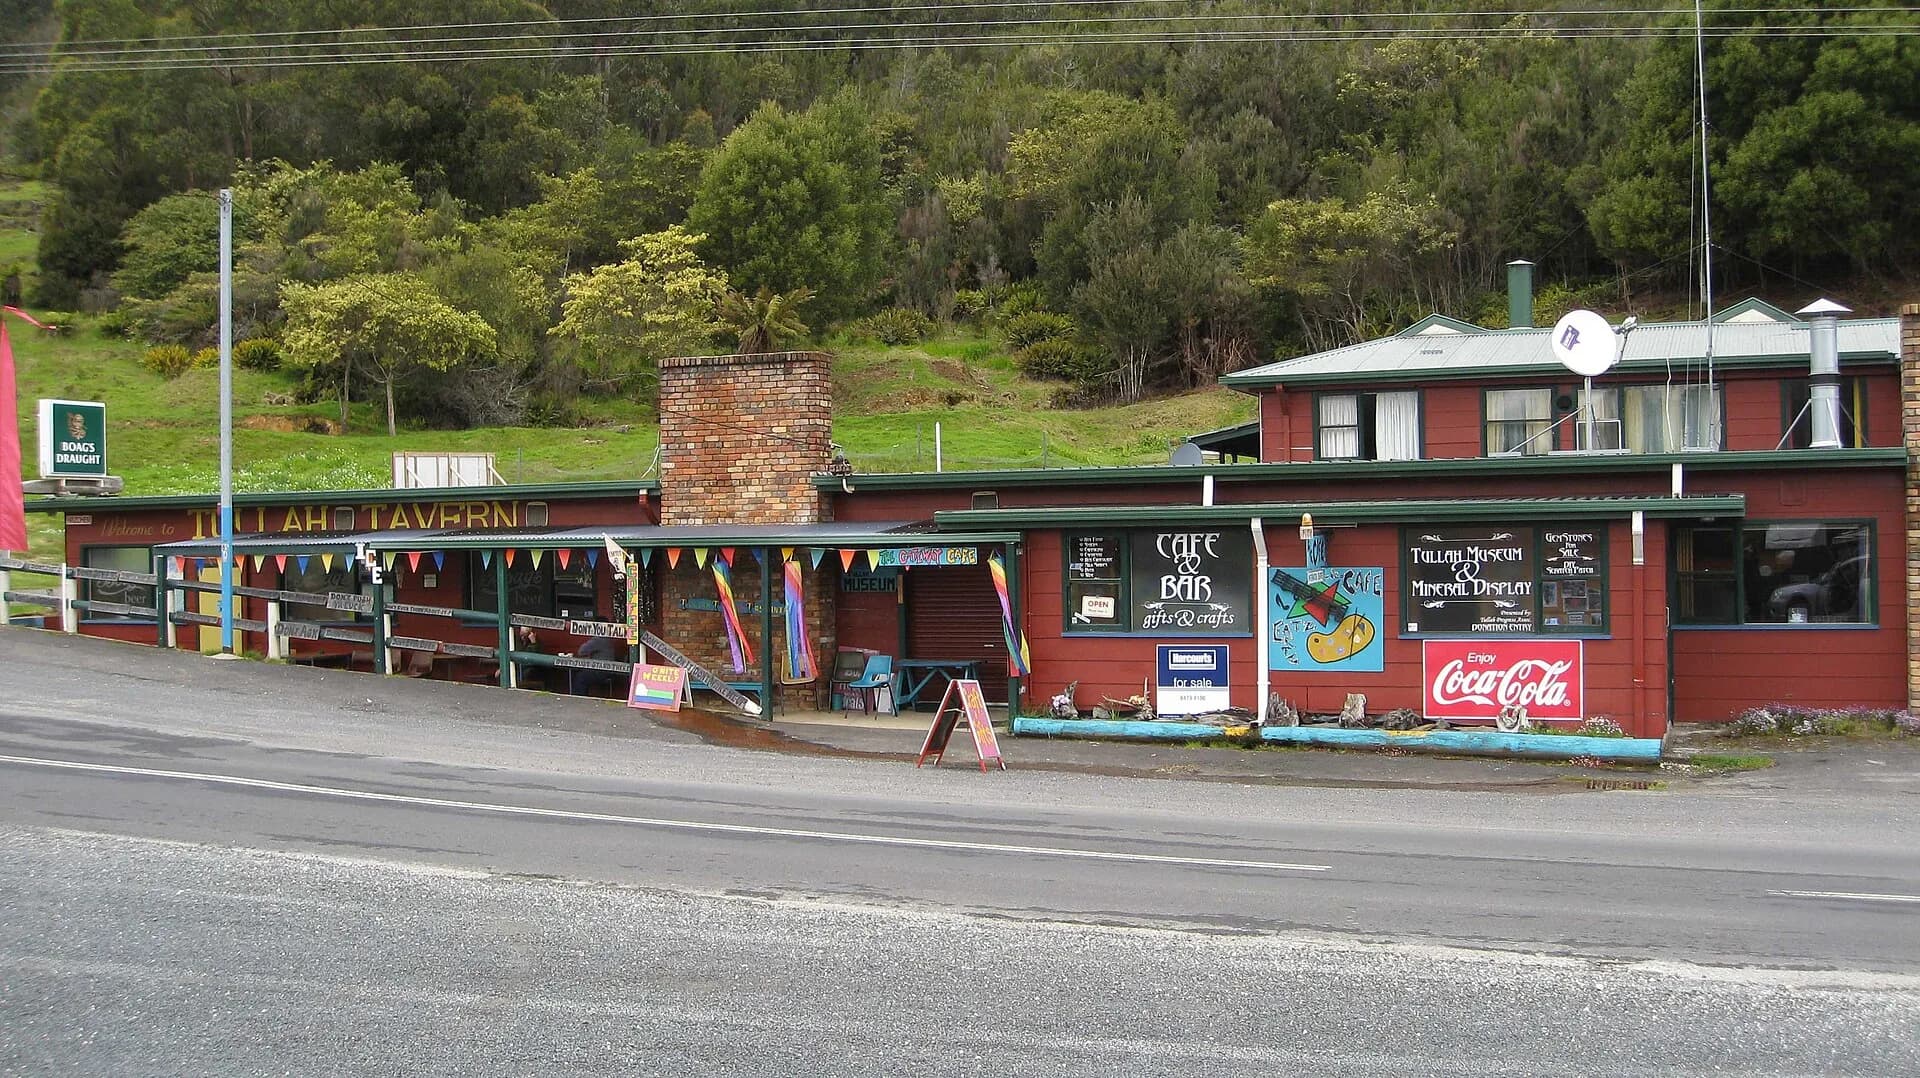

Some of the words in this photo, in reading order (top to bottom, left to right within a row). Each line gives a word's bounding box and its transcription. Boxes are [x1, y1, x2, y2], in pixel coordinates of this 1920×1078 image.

[62, 442, 95, 453] BOAG'S
[56, 453, 101, 465] DRAUGHT
[361, 501, 519, 530] TAVERN
[101, 518, 154, 536] Welcome
[161, 523, 176, 535] to
[1156, 533, 1221, 559] CAFE
[1410, 547, 1462, 564] TULLAH
[1467, 546, 1523, 563] MUSEUM
[355, 543, 383, 585] ICE
[1174, 552, 1201, 575] &
[1451, 559, 1480, 583] &
[843, 577, 896, 591] MUSEUM
[1160, 574, 1213, 602] BAR
[1342, 569, 1381, 596] CAFE
[1411, 579, 1470, 597] MINERAL
[1473, 578, 1532, 597] DISPLAY
[124, 591, 147, 604] beer
[626, 565, 638, 641] COFFEE
[1087, 600, 1109, 608] OPEN
[1142, 609, 1173, 629] gifts
[1174, 609, 1195, 627] &
[1196, 609, 1235, 629] crafts
[1172, 652, 1213, 664] Harcourts
[1467, 653, 1496, 665] Enjoy
[1173, 676, 1188, 688] for
[1190, 676, 1213, 688] sale
[1432, 659, 1573, 706] Coca-Cola
